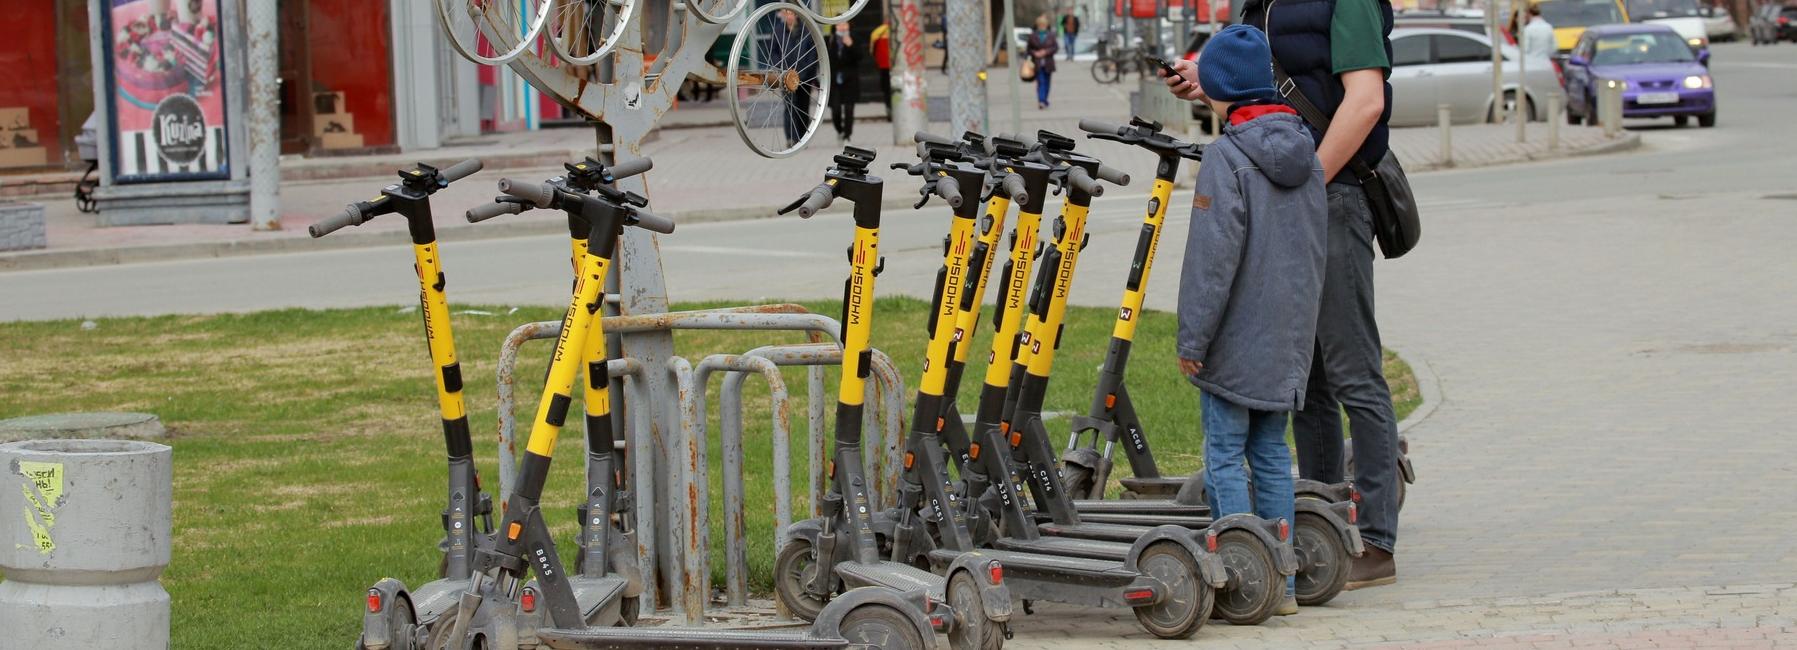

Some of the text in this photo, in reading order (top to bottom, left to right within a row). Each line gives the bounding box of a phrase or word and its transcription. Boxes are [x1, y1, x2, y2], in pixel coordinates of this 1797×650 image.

[159, 113, 204, 146] Kuzina
[850, 265, 864, 325] WHOOSH
[943, 256, 963, 316] WHOOSH
[1009, 250, 1029, 309] WHOOSH
[1056, 242, 1077, 298] WHOOSH
[555, 295, 580, 362] WHOOSH
[1040, 470, 1052, 491] CF14
